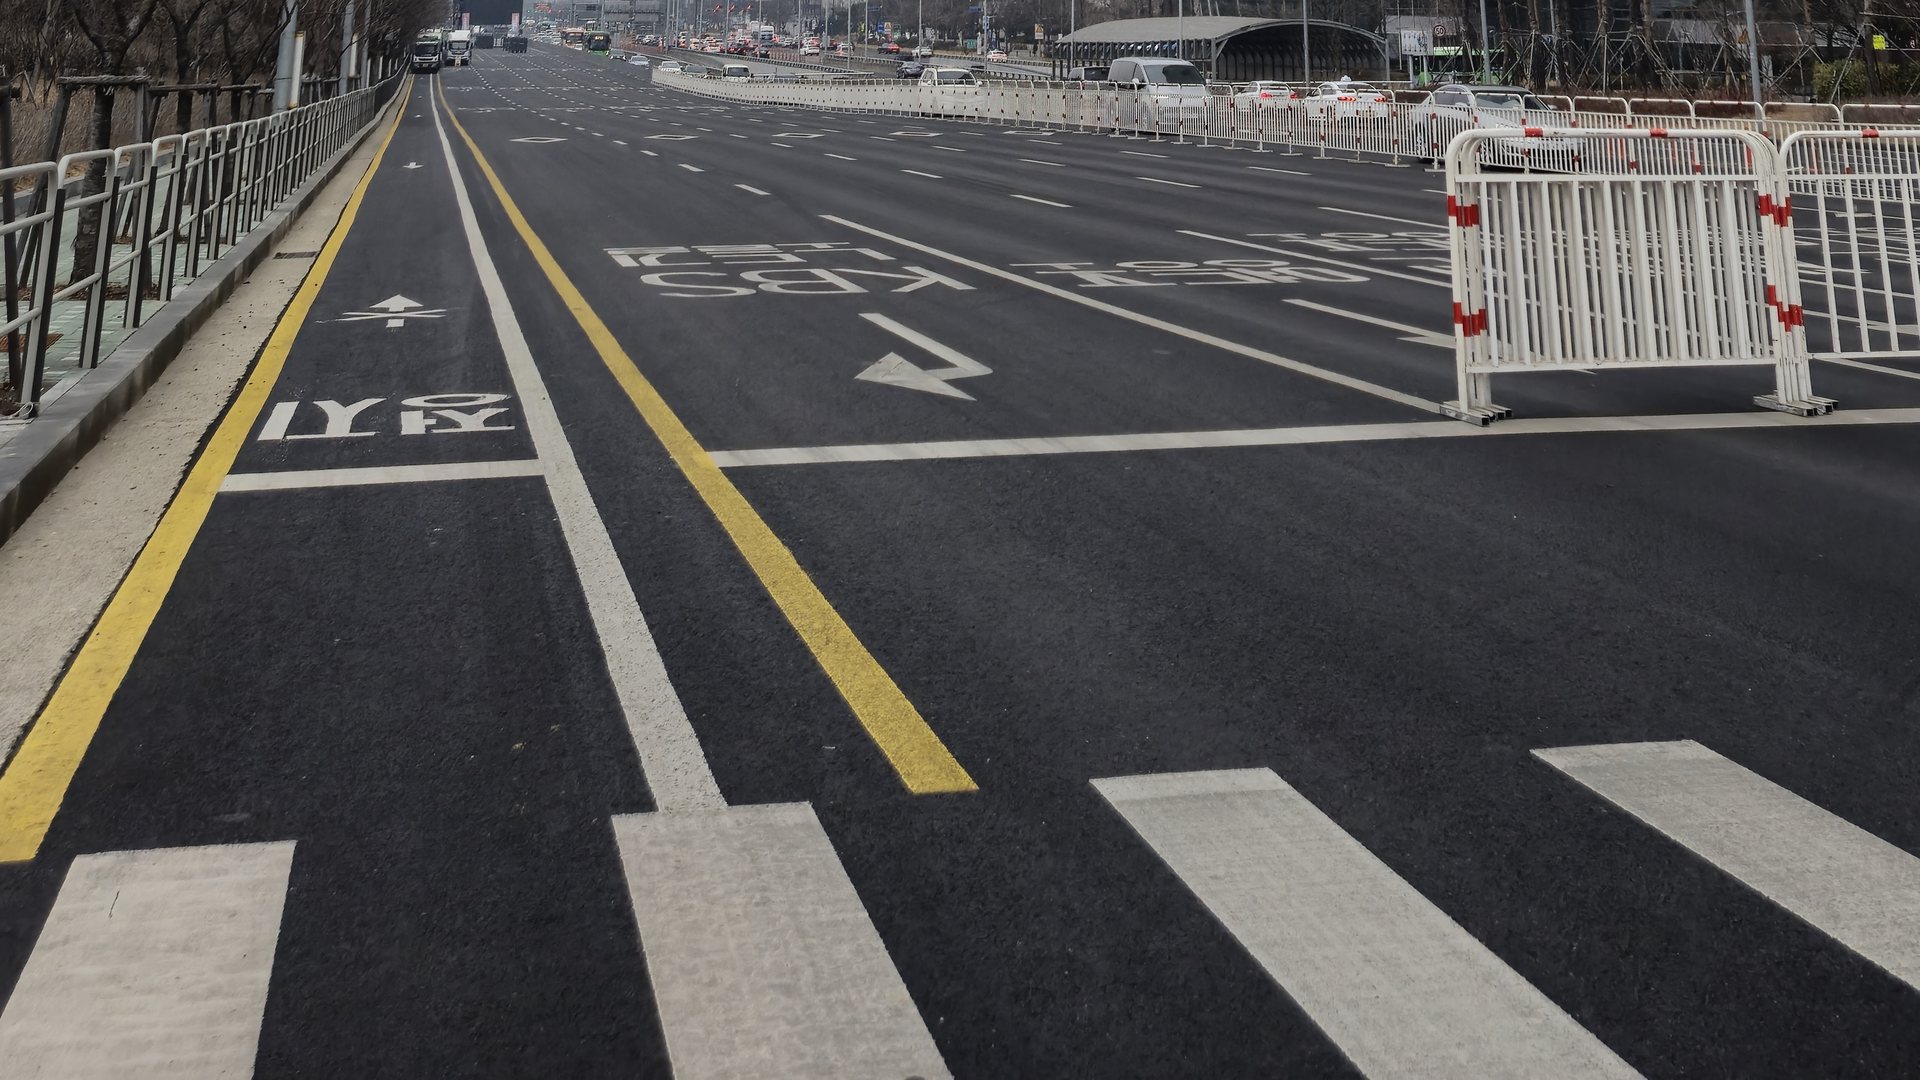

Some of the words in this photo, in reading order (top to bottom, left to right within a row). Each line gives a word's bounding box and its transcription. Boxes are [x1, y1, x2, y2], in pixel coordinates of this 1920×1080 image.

[603, 241, 897, 268] 노들길
[640, 265, 977, 298] KBS
[1009, 259, 1371, 287] 영등포
[257, 393, 516, 441] 정지
